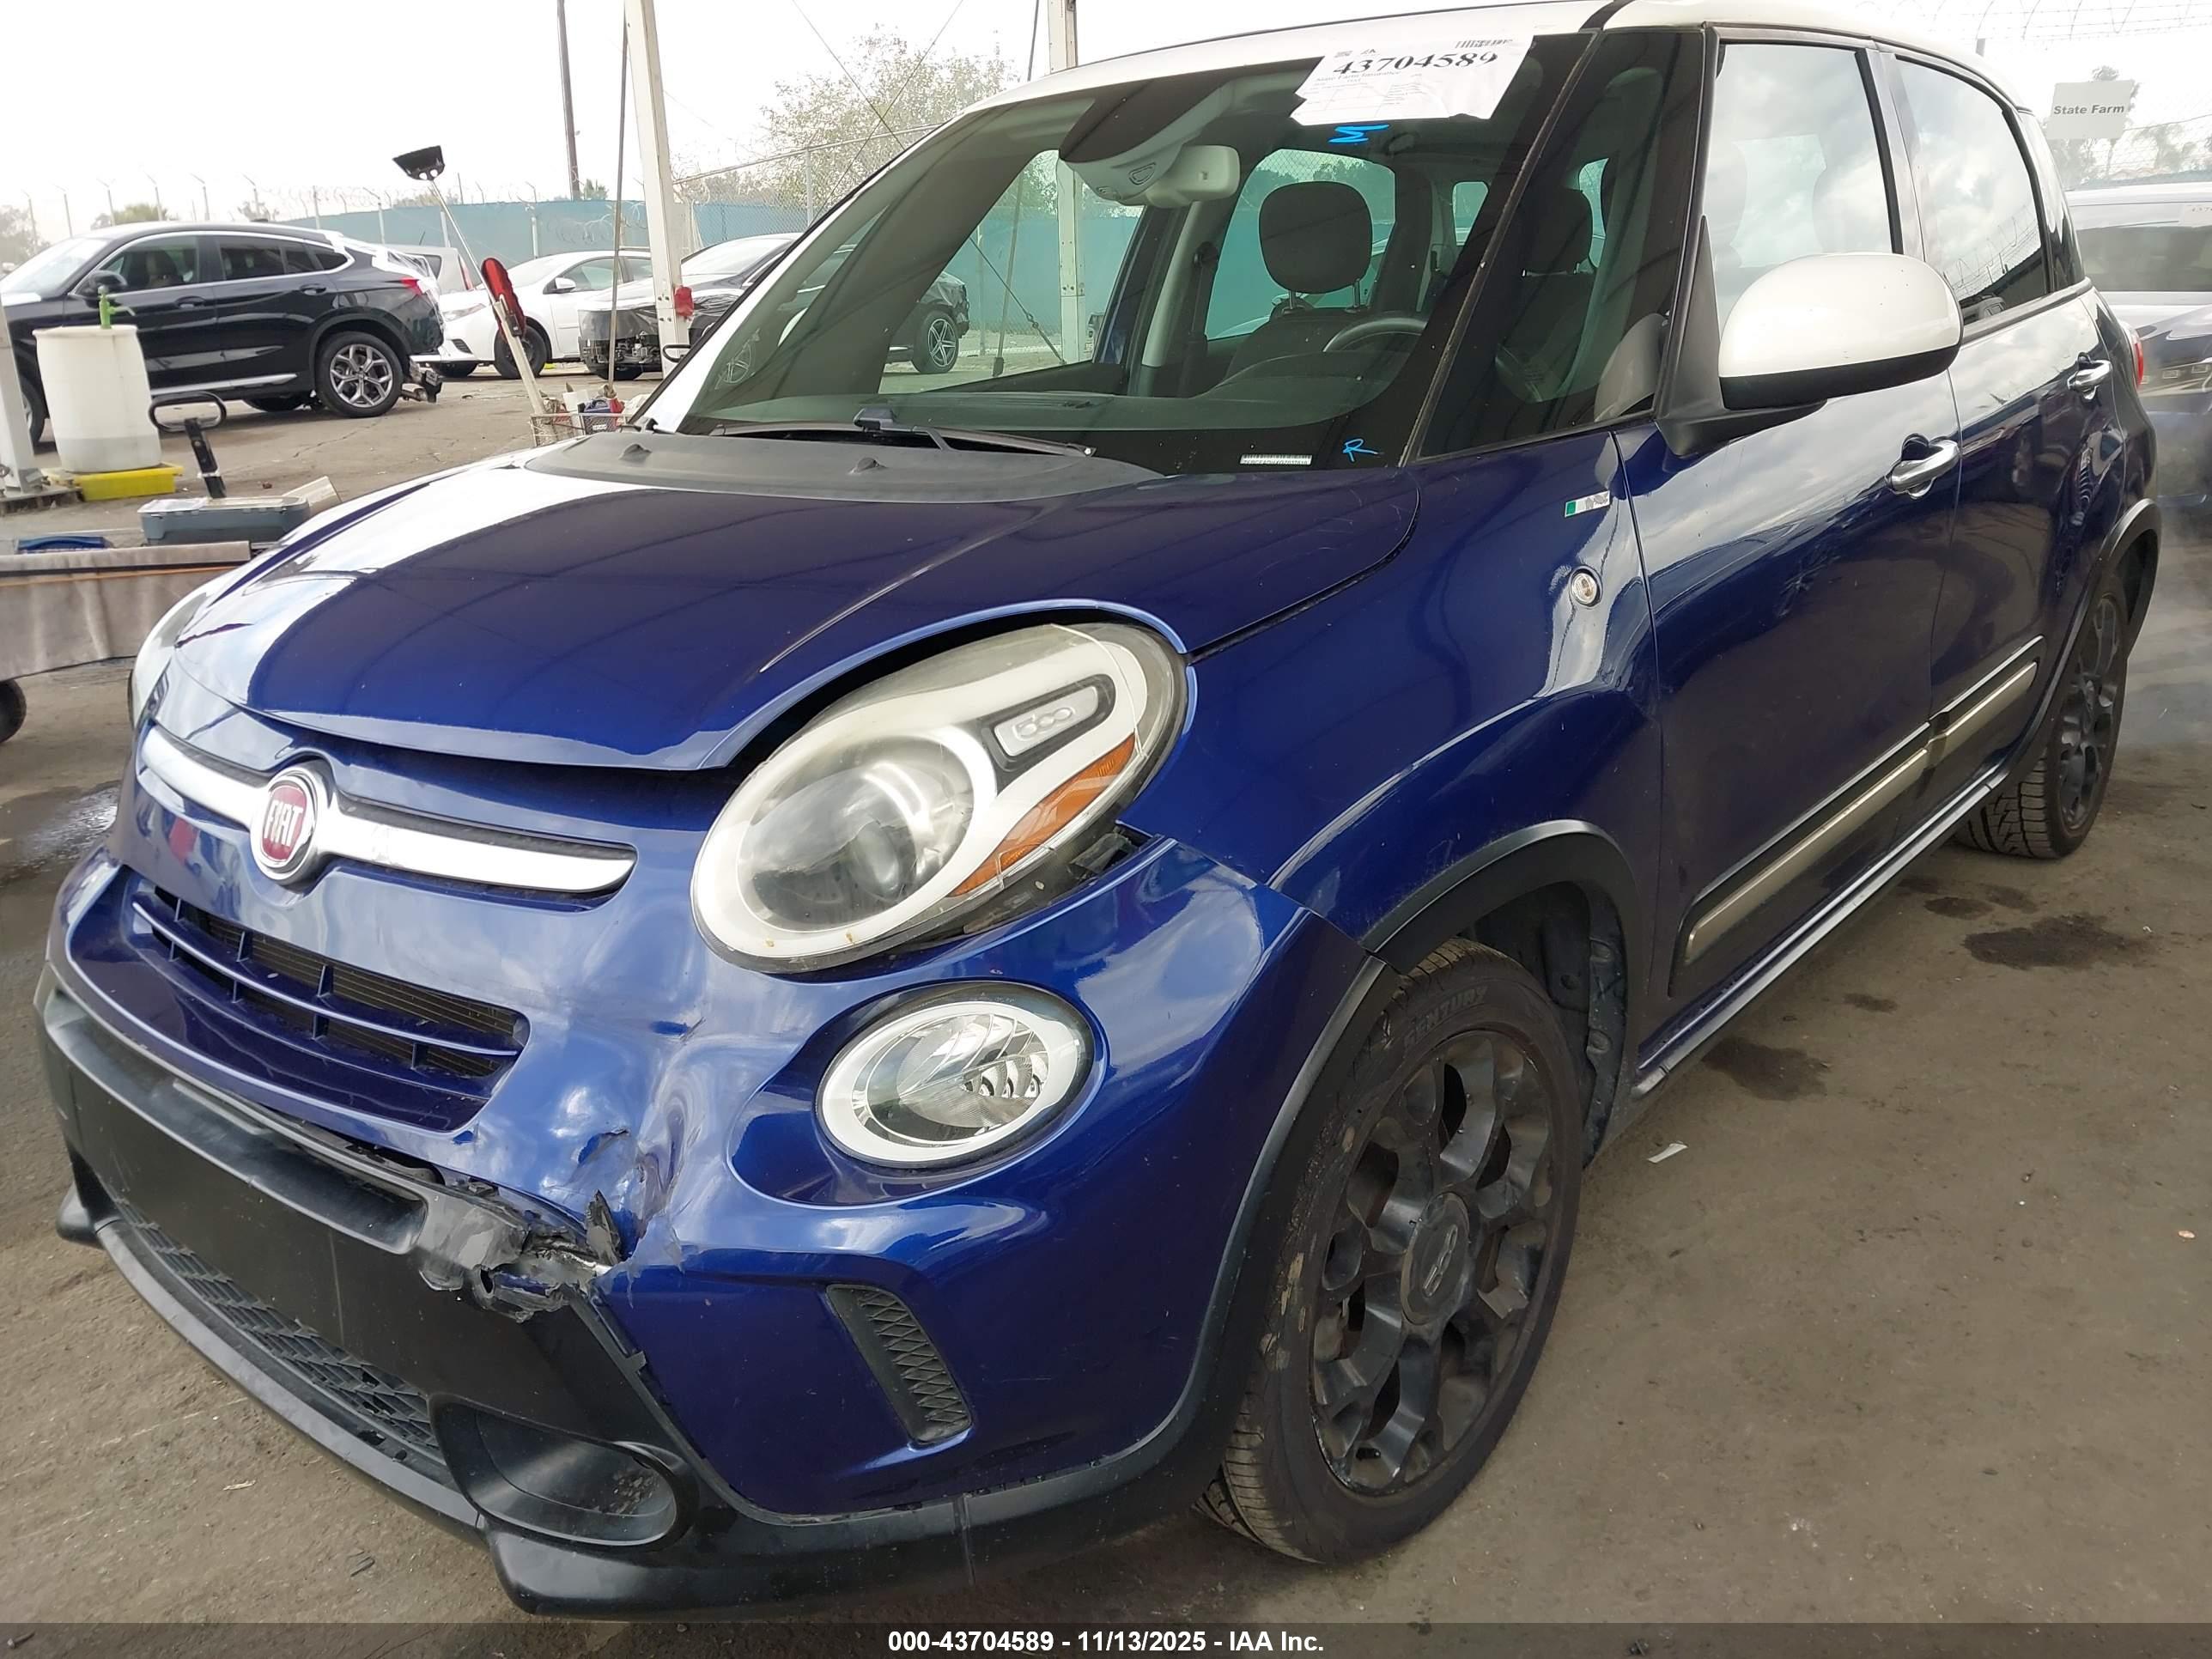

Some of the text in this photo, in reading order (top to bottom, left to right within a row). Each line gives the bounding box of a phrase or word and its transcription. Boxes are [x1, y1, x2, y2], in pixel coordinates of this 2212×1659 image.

[1334, 52, 1498, 75] 43704589
[2053, 105, 2124, 114] State Farm
[1342, 438, 1380, 463] R
[264, 799, 304, 848] FIAT
